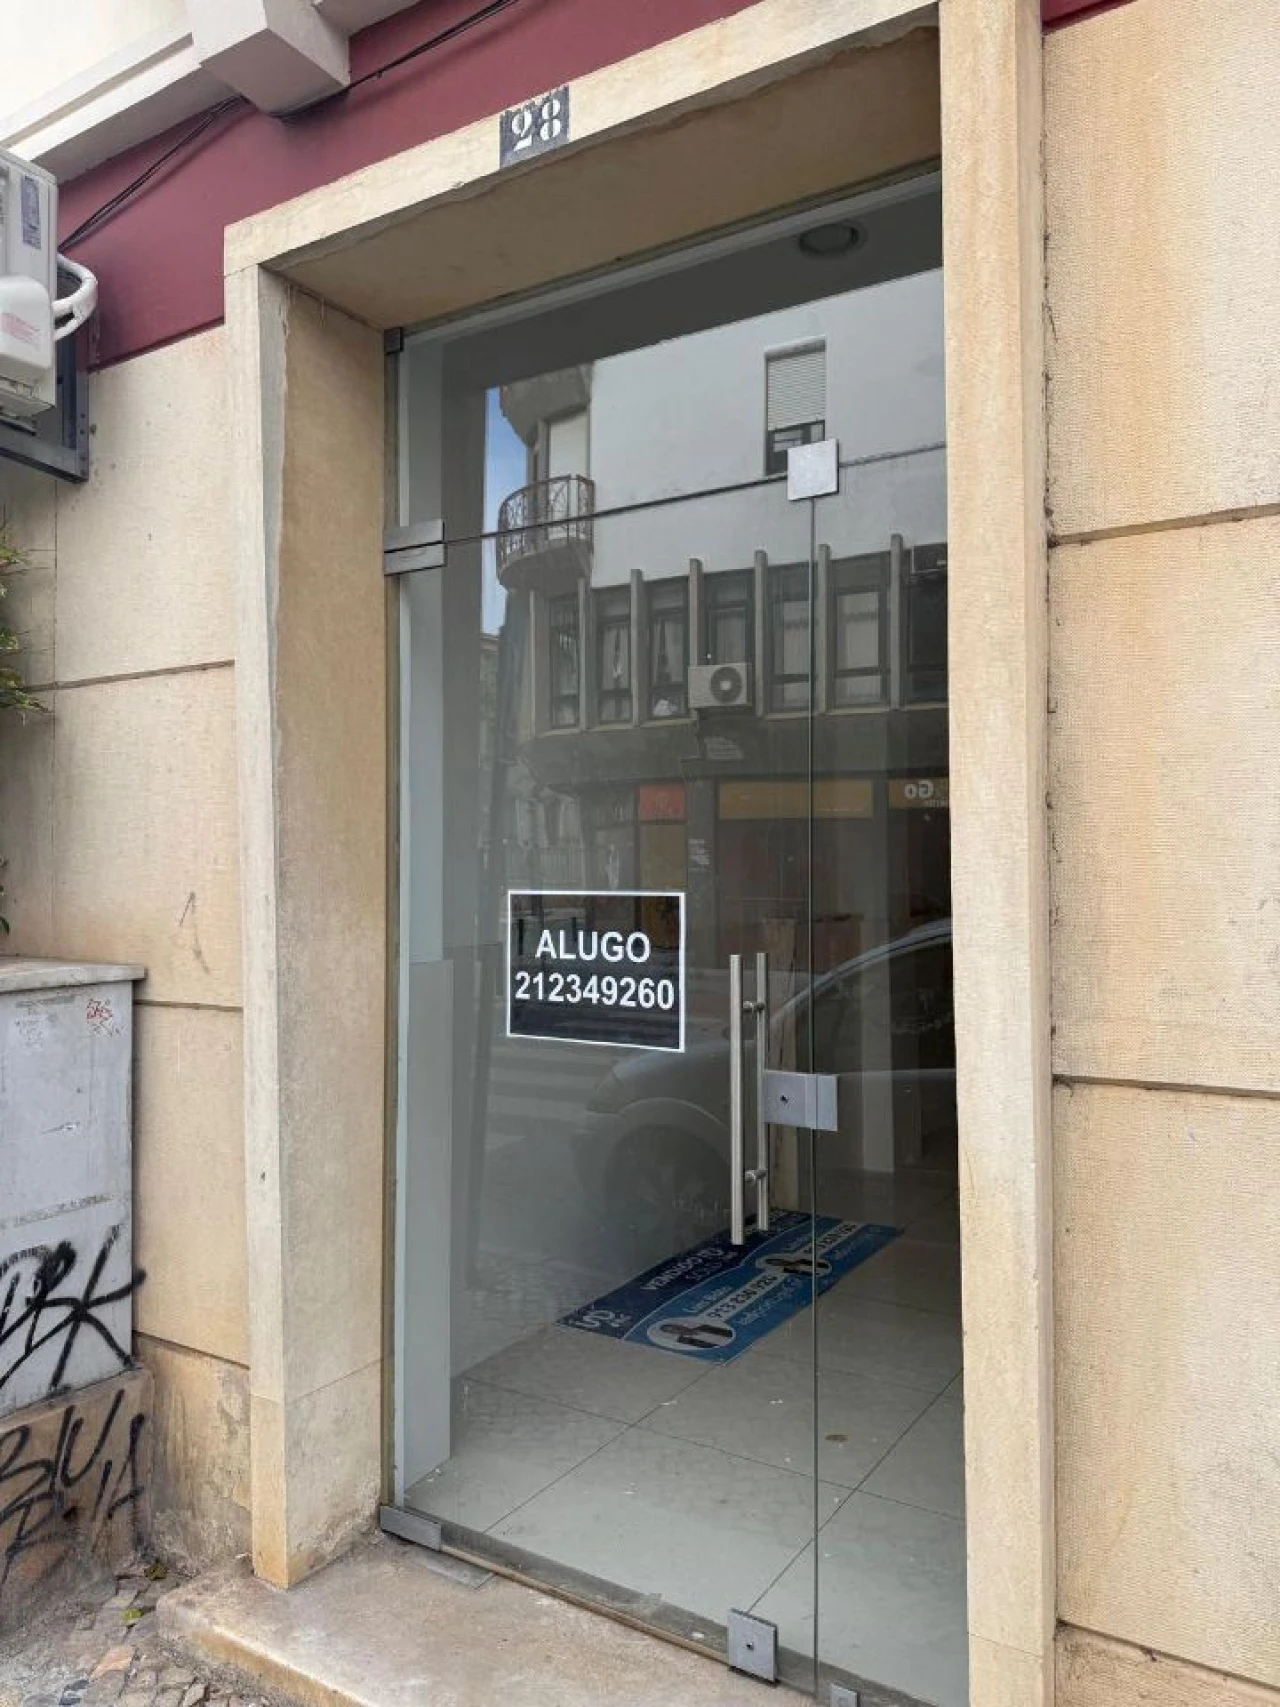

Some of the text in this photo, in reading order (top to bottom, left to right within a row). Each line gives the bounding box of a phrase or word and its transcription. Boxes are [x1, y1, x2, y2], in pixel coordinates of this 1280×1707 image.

[511, 98, 561, 152] 28
[535, 929, 651, 963] ALUGO
[515, 970, 675, 1010] 212349260
